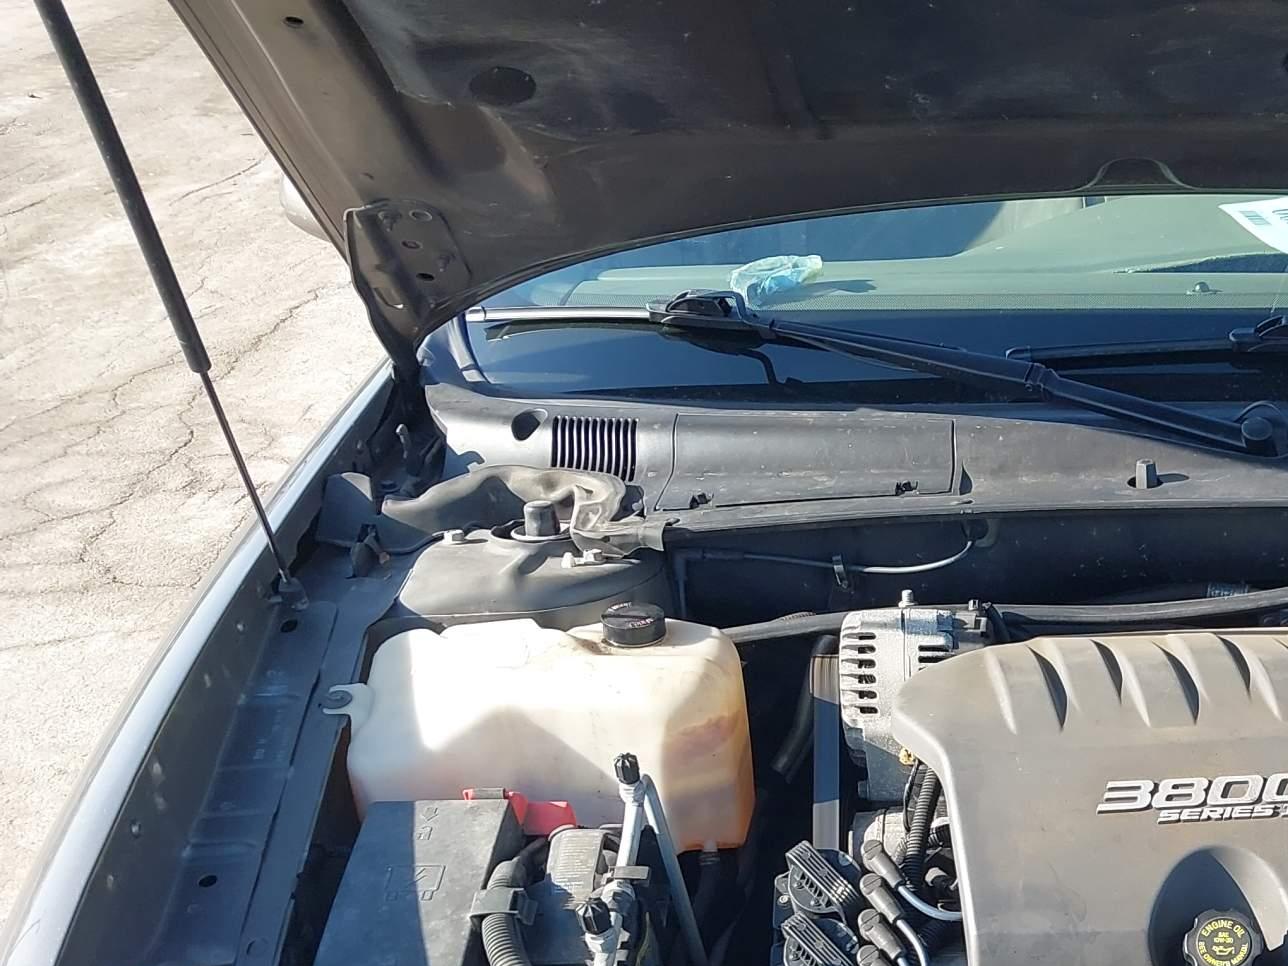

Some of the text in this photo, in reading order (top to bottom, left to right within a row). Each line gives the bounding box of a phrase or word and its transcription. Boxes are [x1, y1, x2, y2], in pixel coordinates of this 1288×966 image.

[1157, 805, 1278, 824] SERIES
[1202, 920, 1245, 938] ENGINE OIL
